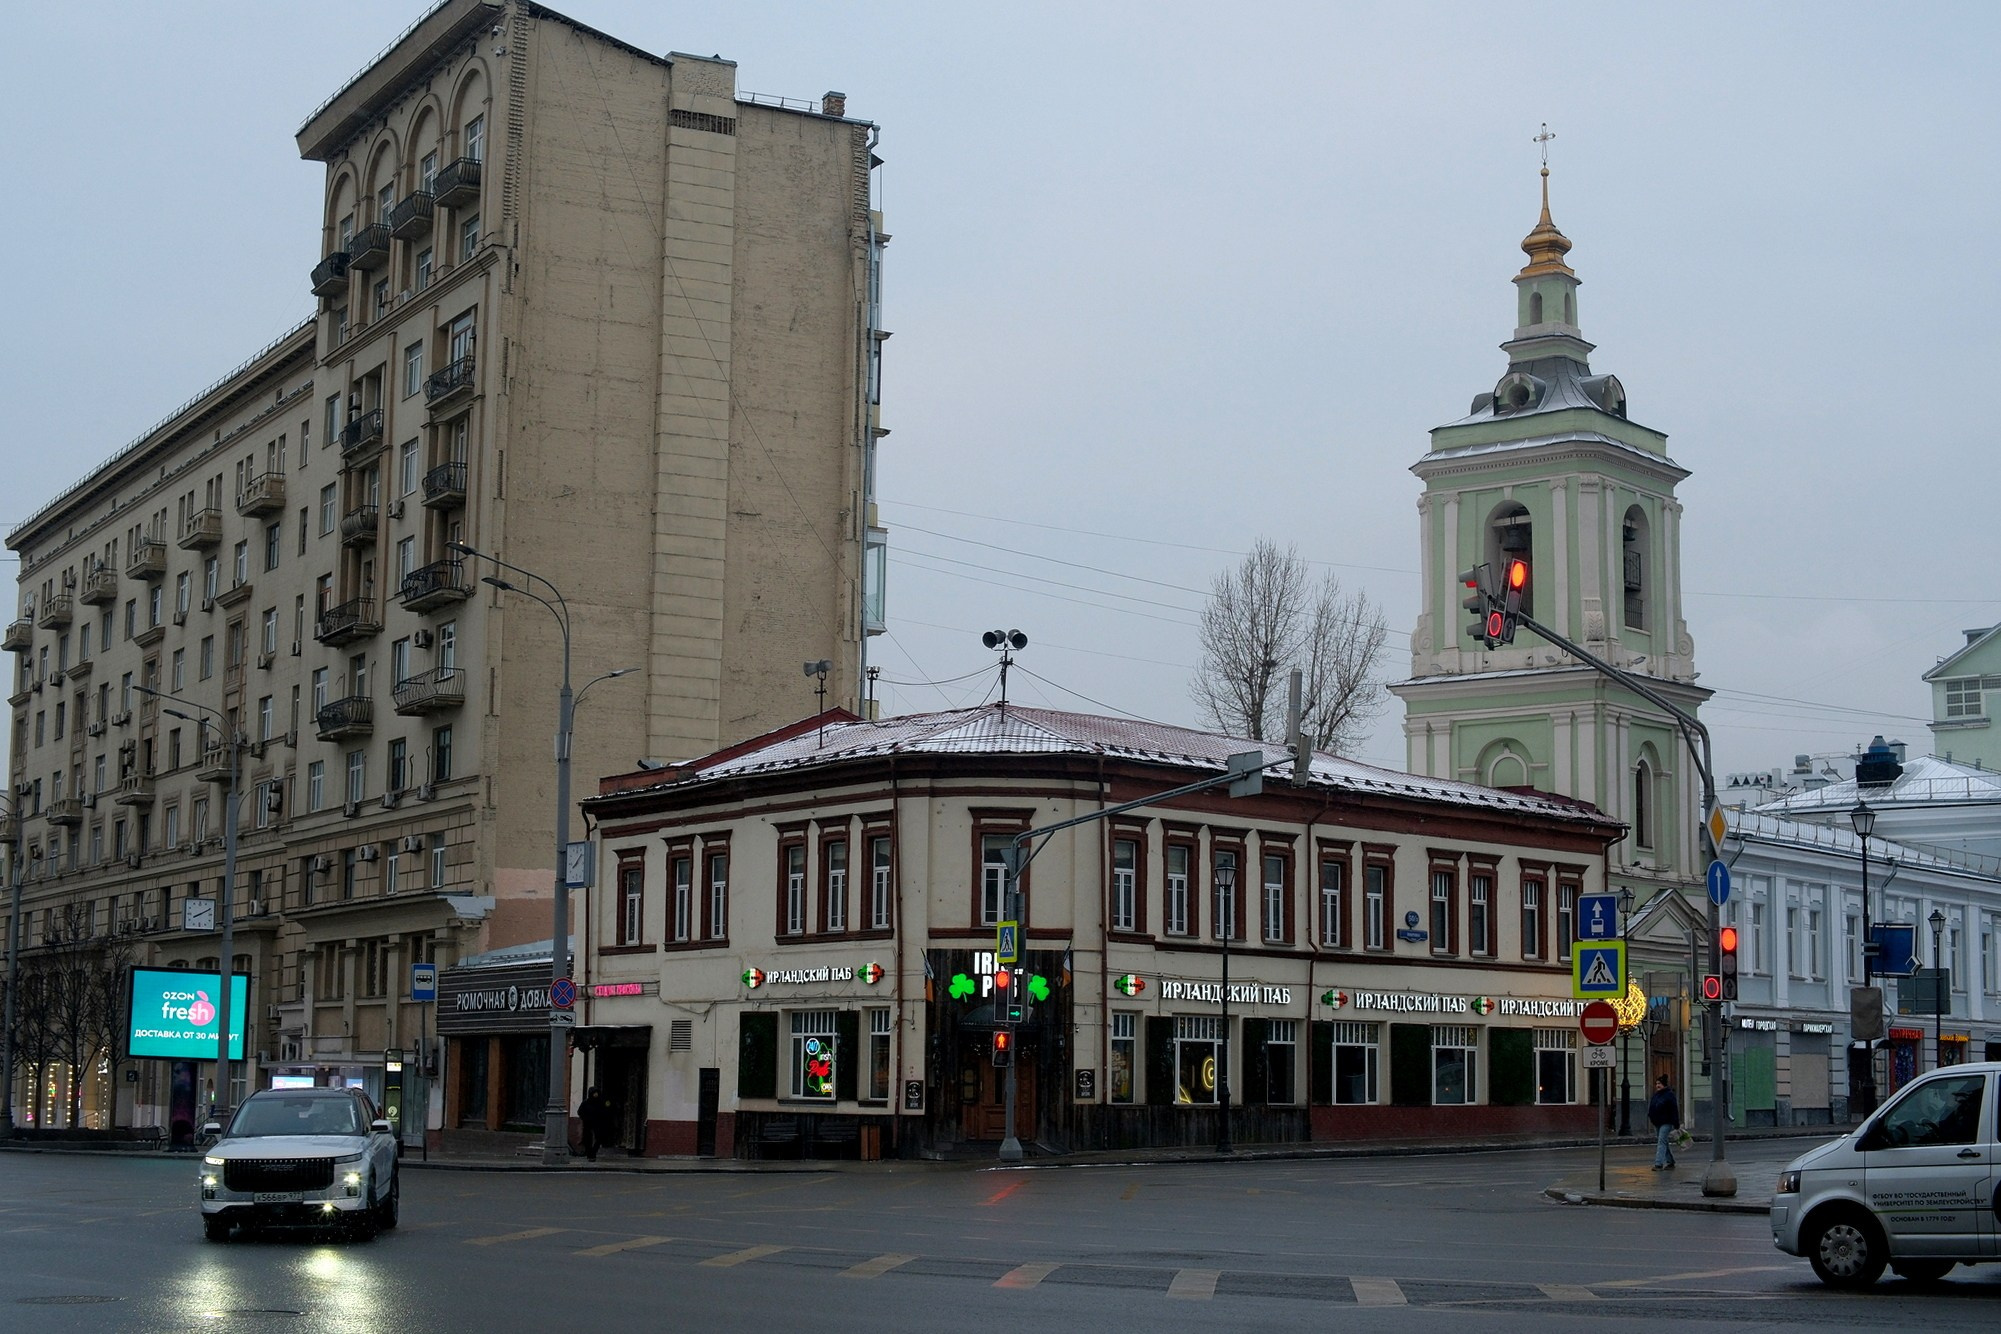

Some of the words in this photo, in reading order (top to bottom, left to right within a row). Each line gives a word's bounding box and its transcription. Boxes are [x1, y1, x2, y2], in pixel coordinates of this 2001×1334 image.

[767, 966, 829, 984] ИРЛАНДСКИЙ
[832, 967, 853, 980] ПАБ
[163, 991, 195, 1000] OZON
[456, 991, 506, 1010] РЮМОЧНАЯ
[520, 989, 553, 1010] ДОВЛА
[1162, 981, 1259, 1003] ИРЛАНДСКИЙ
[1263, 987, 1291, 1004] ПАБ
[162, 1001, 209, 1021] fresh
[1355, 992, 1439, 1013] ИРЛАНДСКИЙ
[1443, 996, 1466, 1013] ПАБ
[1501, 999, 1574, 1018] ИРЛАНДСКИЙ
[134, 1029, 181, 1039] ДОСТАВКА
[182, 1031, 195, 1039] ОТ
[196, 1032, 206, 1040] 30
[207, 1033, 240, 1041] МИУТ
